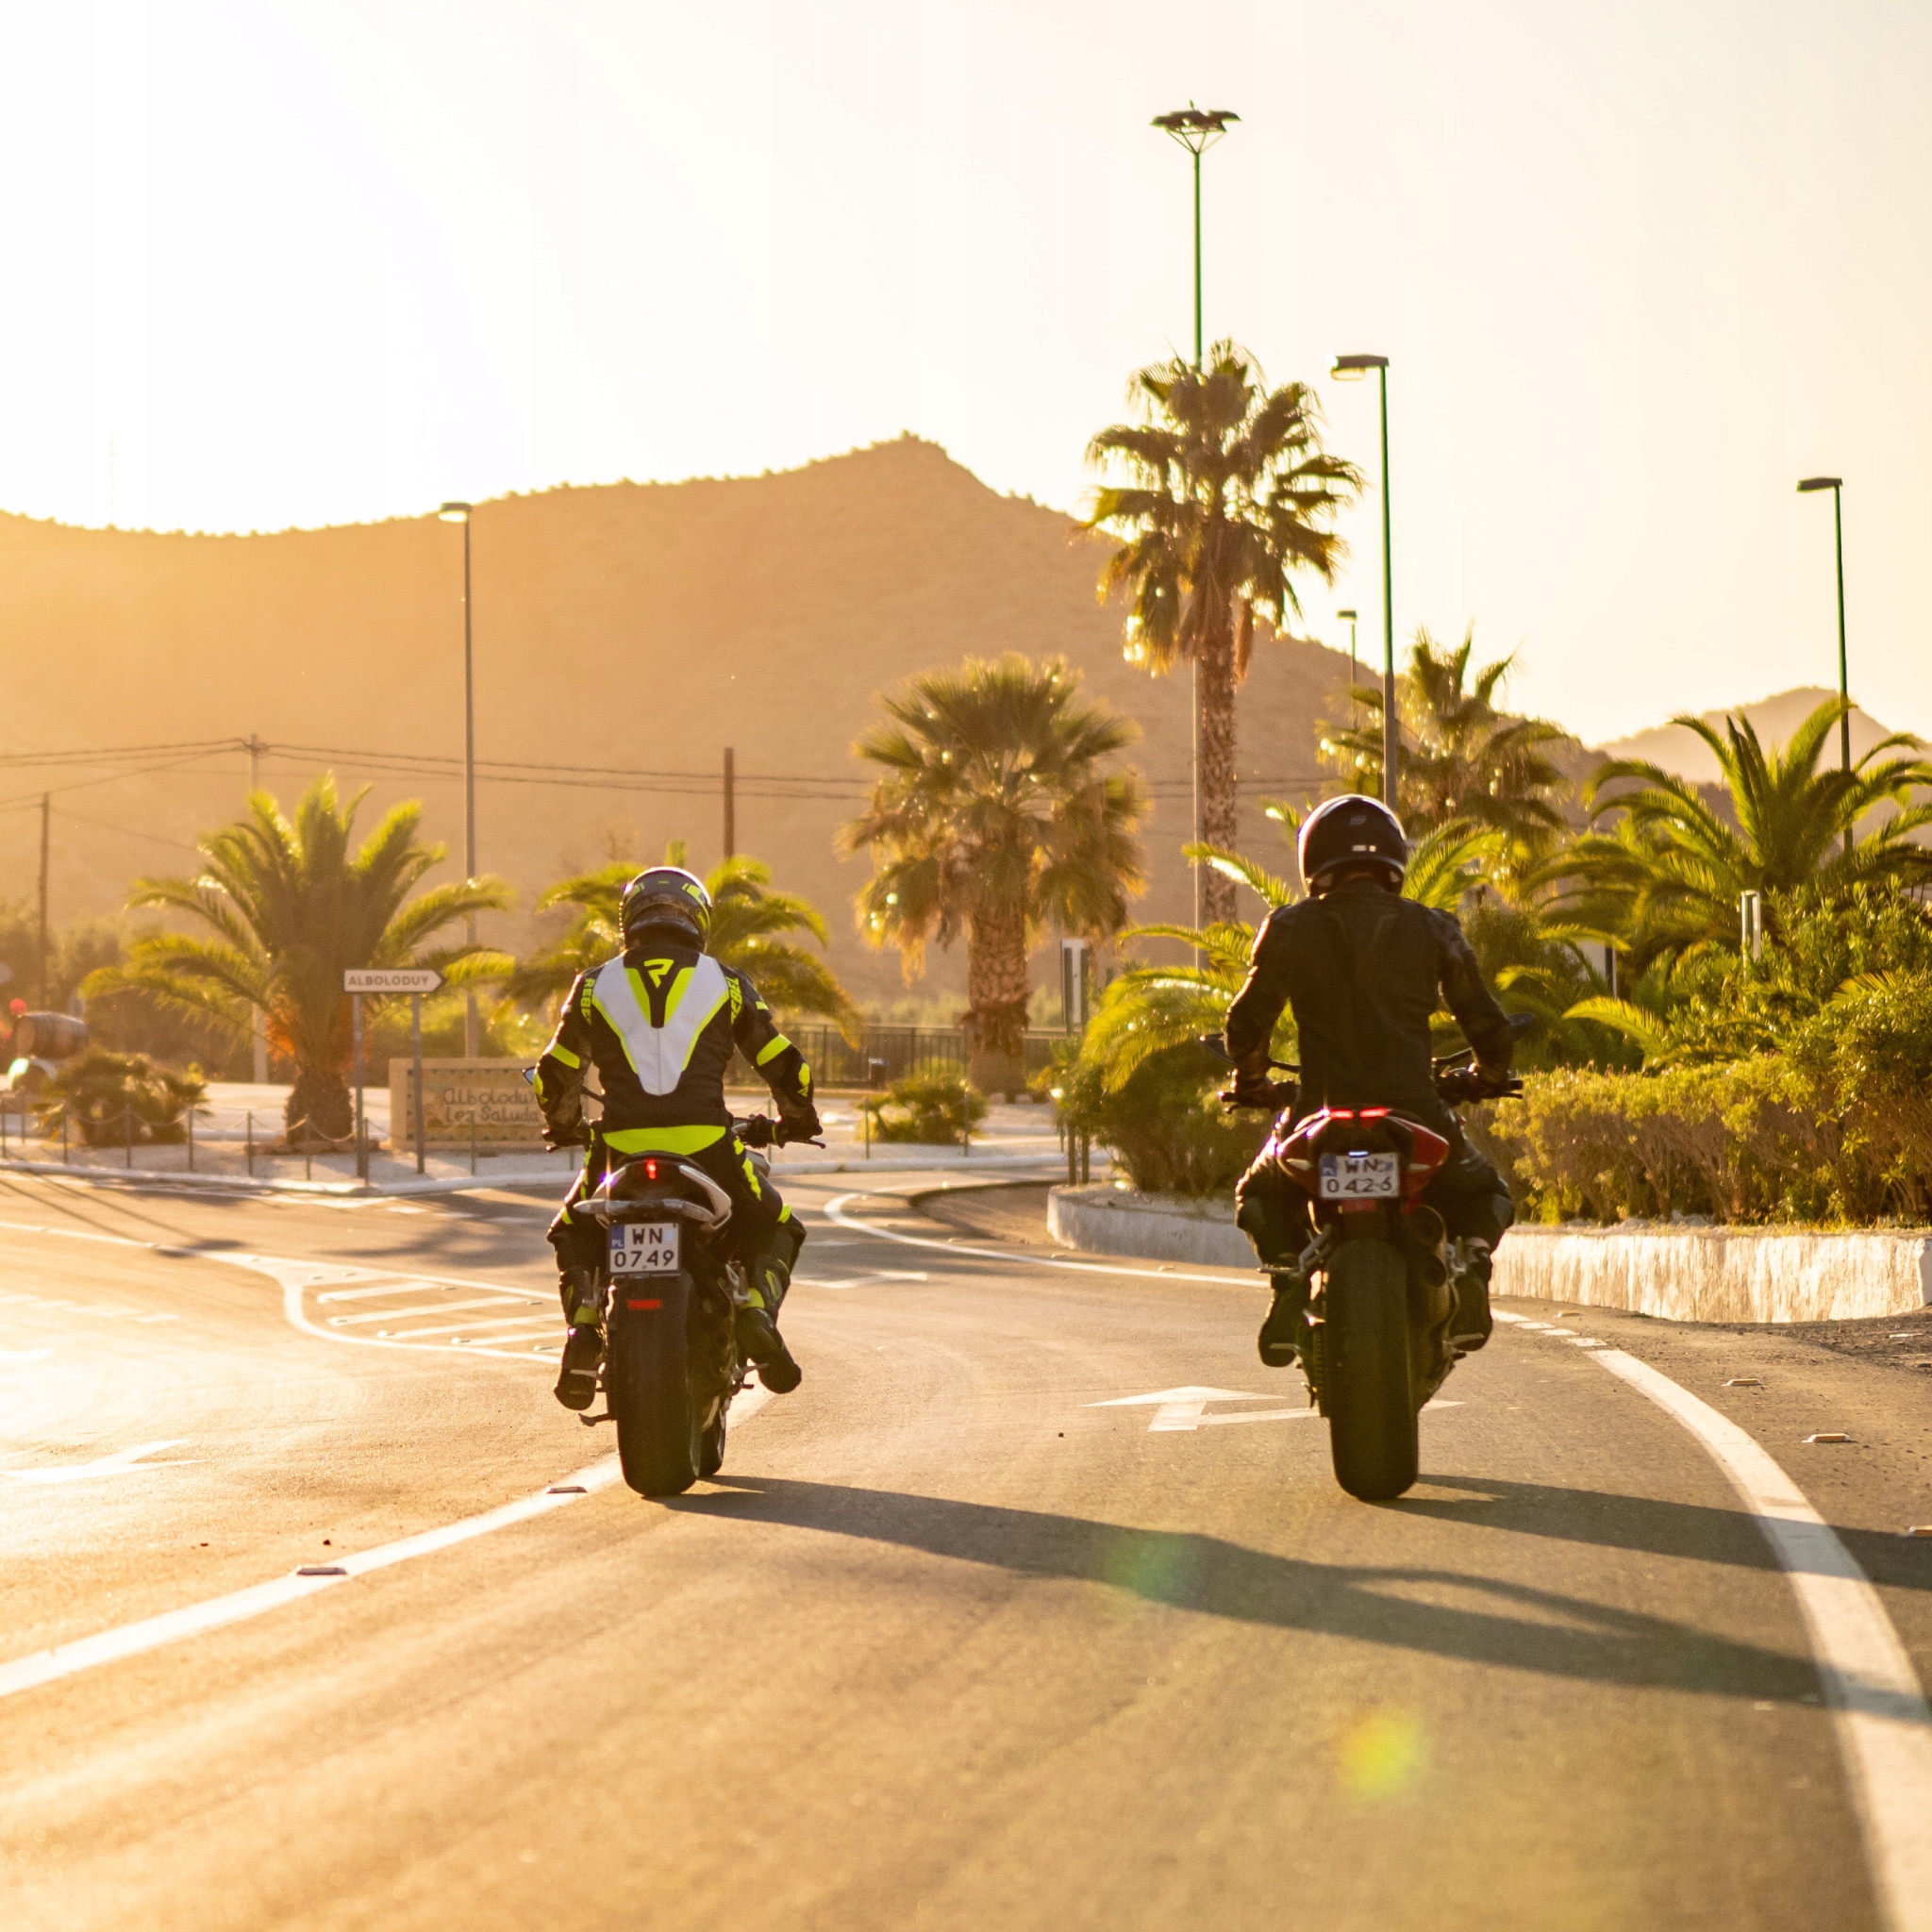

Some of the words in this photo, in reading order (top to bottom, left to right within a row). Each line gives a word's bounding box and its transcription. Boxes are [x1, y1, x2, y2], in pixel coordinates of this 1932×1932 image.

[348, 974, 429, 986] ALBOLODUY
[1325, 1176, 1392, 1193] 0426
[632, 1228, 663, 1244] WN
[614, 1249, 675, 1268] 0749
